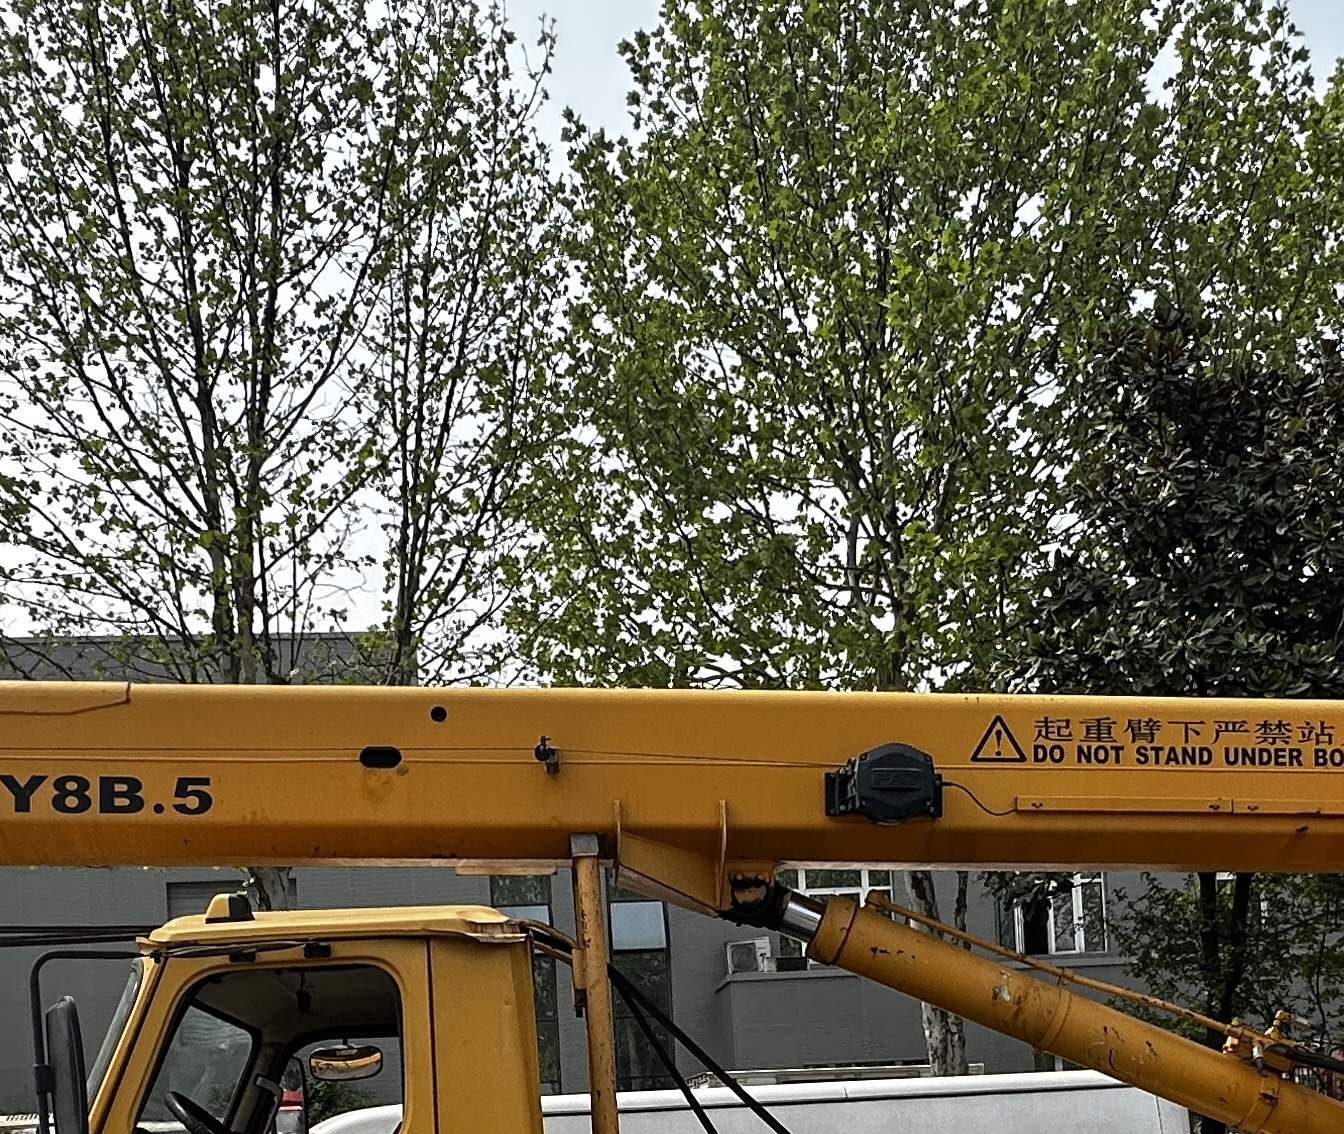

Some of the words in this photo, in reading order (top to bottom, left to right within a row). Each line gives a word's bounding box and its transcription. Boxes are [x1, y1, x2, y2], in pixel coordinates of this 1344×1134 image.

[1033, 744, 1066, 764] DO
[1077, 745, 1124, 765] NOT
[1135, 745, 1214, 766] STAND
[1223, 746, 1304, 767] UNDER
